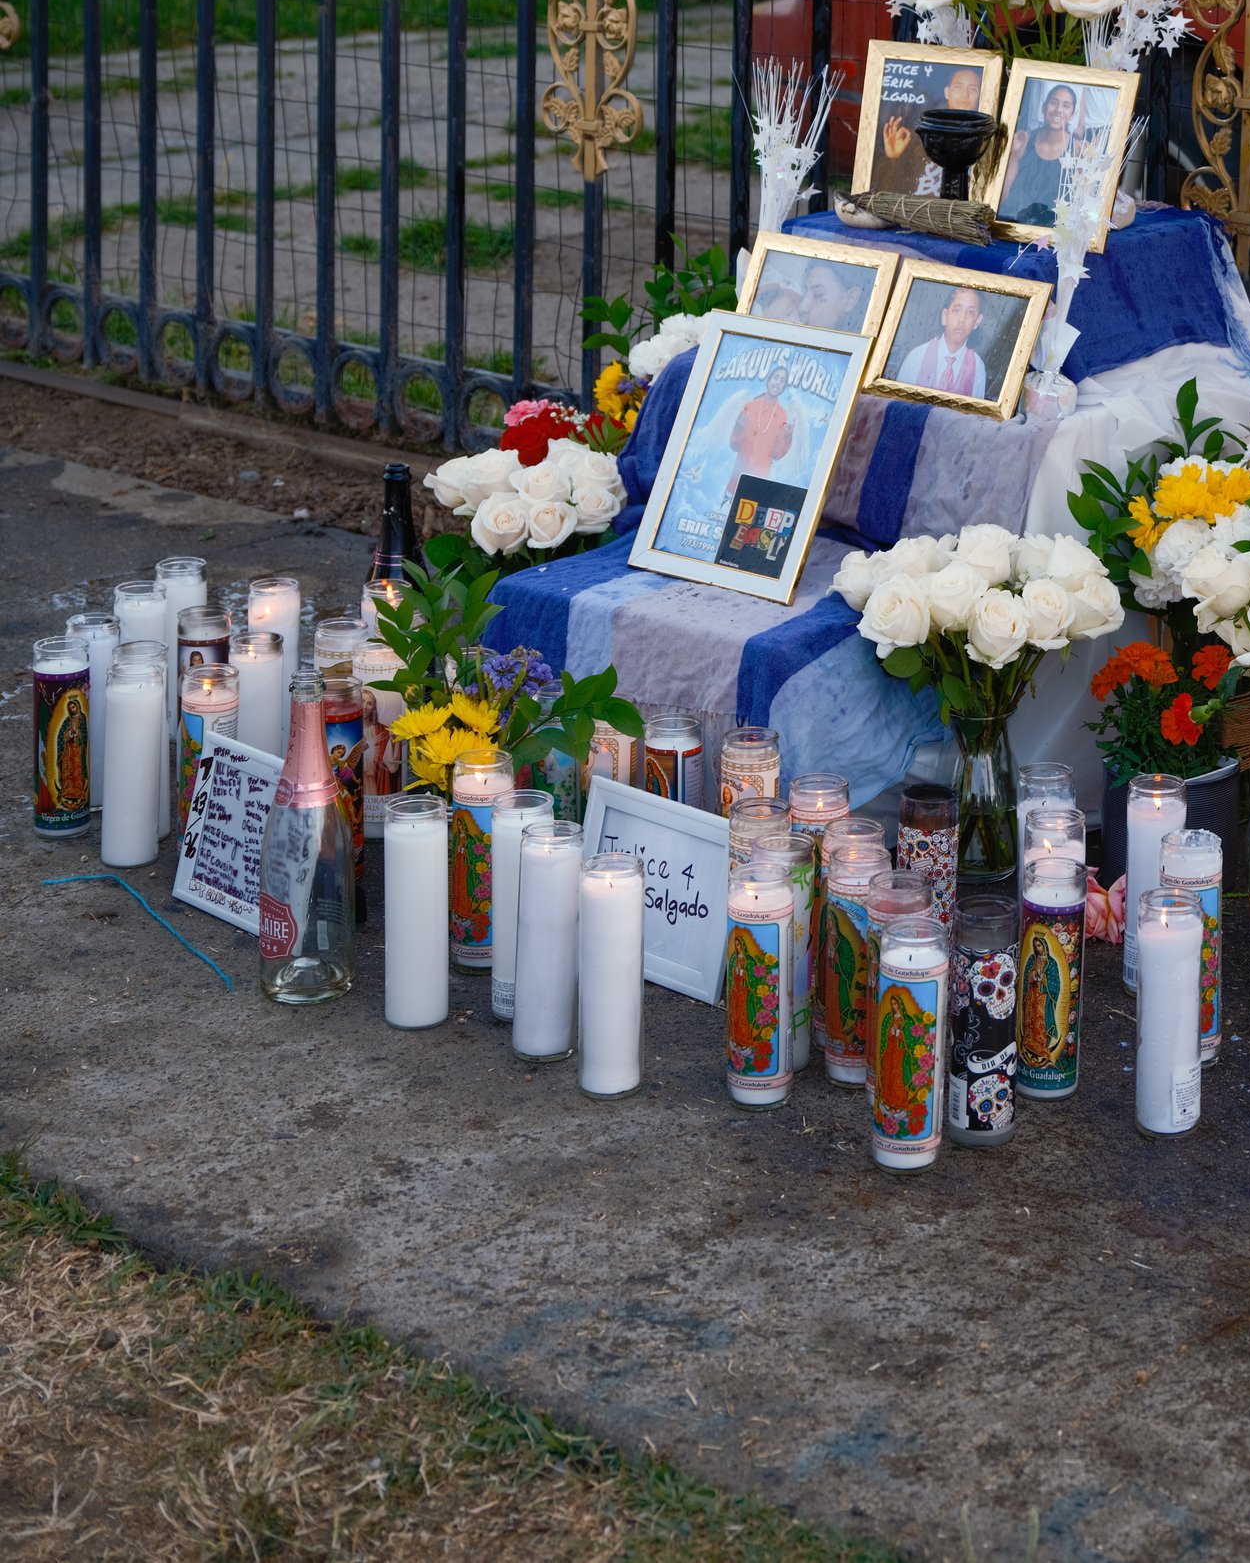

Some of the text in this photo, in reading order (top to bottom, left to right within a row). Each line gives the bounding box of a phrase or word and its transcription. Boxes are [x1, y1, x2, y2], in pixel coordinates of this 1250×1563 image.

[924, 65, 933, 77] 4
[882, 75, 914, 89] ERIK
[787, 350, 840, 405] WORLD
[738, 500, 795, 533] DEEP
[677, 517, 711, 538] ERIK
[681, 863, 695, 890] 4
[1182, 877, 1214, 886] Guadalupe
[644, 886, 709, 925] Salgado
[737, 911, 771, 921] Guadalupe
[895, 969, 931, 978] Guadalupe
[981, 1060, 996, 1071] DIA
[739, 1079, 772, 1089] Guadalupe
[1029, 1070, 1067, 1084] Guadalupe
